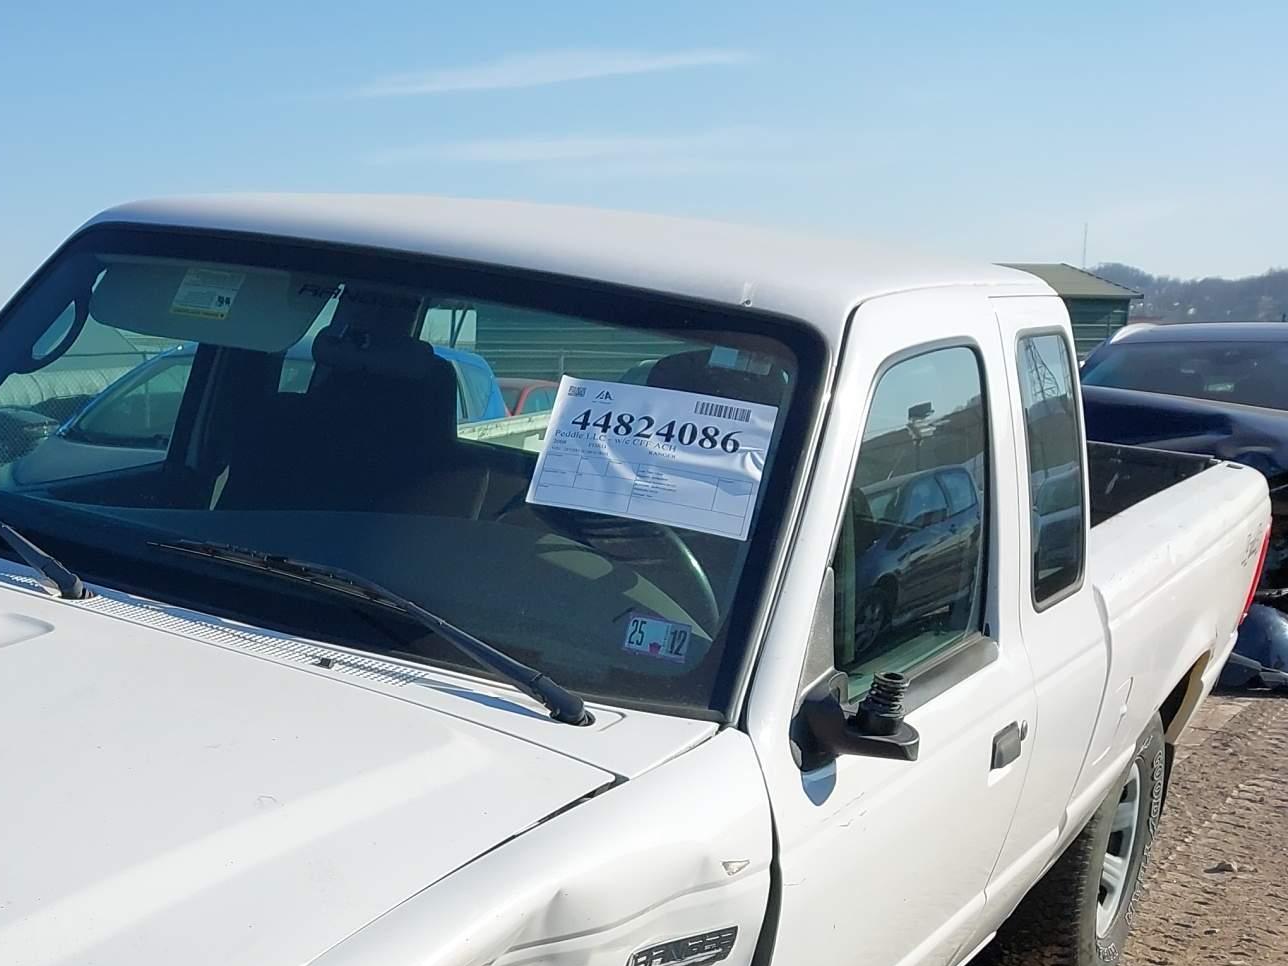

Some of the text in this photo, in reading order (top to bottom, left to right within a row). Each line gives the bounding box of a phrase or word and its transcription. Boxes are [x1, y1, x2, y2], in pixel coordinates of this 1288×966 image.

[555, 429, 584, 440] Peddle
[572, 408, 743, 453] 44824086
[628, 619, 688, 657] 25 12
